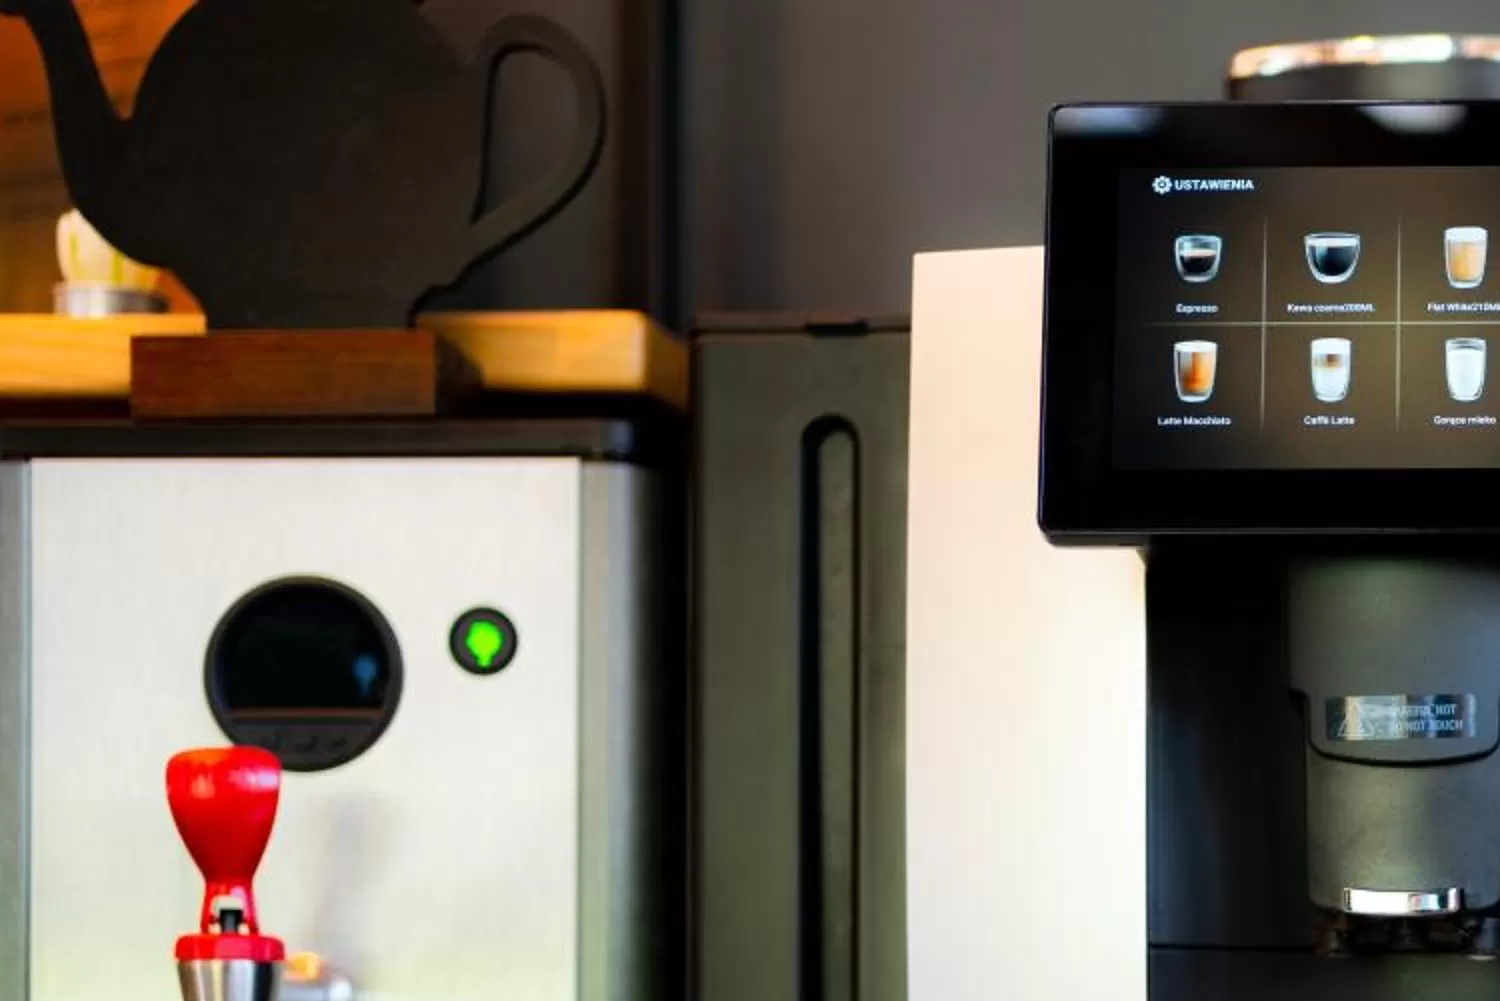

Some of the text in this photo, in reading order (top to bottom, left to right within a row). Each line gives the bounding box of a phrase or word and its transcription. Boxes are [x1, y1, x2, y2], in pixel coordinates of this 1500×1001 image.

[1174, 179, 1254, 191] USTAWIENIA
[1175, 303, 1219, 314] Espresso
[1427, 302, 1445, 312] Flat
[1157, 416, 1232, 426] Latte Macchiato
[1331, 415, 1355, 425] Latte
